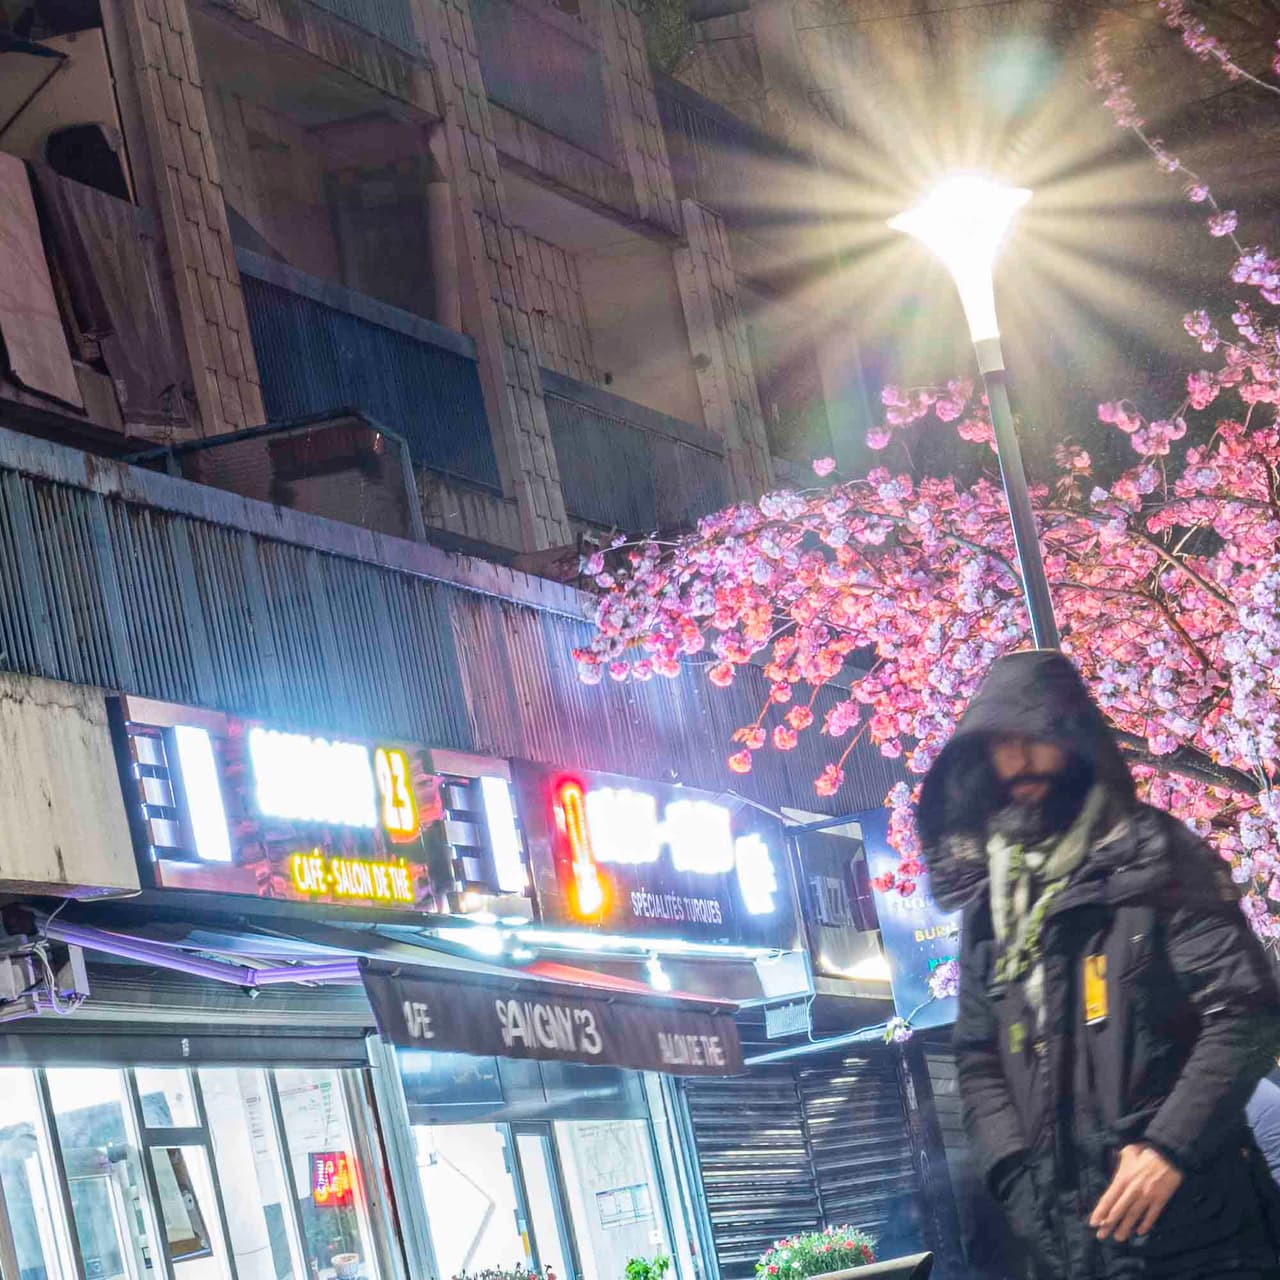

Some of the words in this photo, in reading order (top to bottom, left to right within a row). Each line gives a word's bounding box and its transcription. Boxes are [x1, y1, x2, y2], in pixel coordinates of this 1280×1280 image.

[294, 848, 327, 893] CAFÉ
[332, 858, 374, 897] SALON
[373, 864, 391, 898] DE
[389, 857, 412, 900] THÉ
[631, 887, 685, 920] SPÉCIALITÉS
[683, 897, 723, 924] TURQUES
